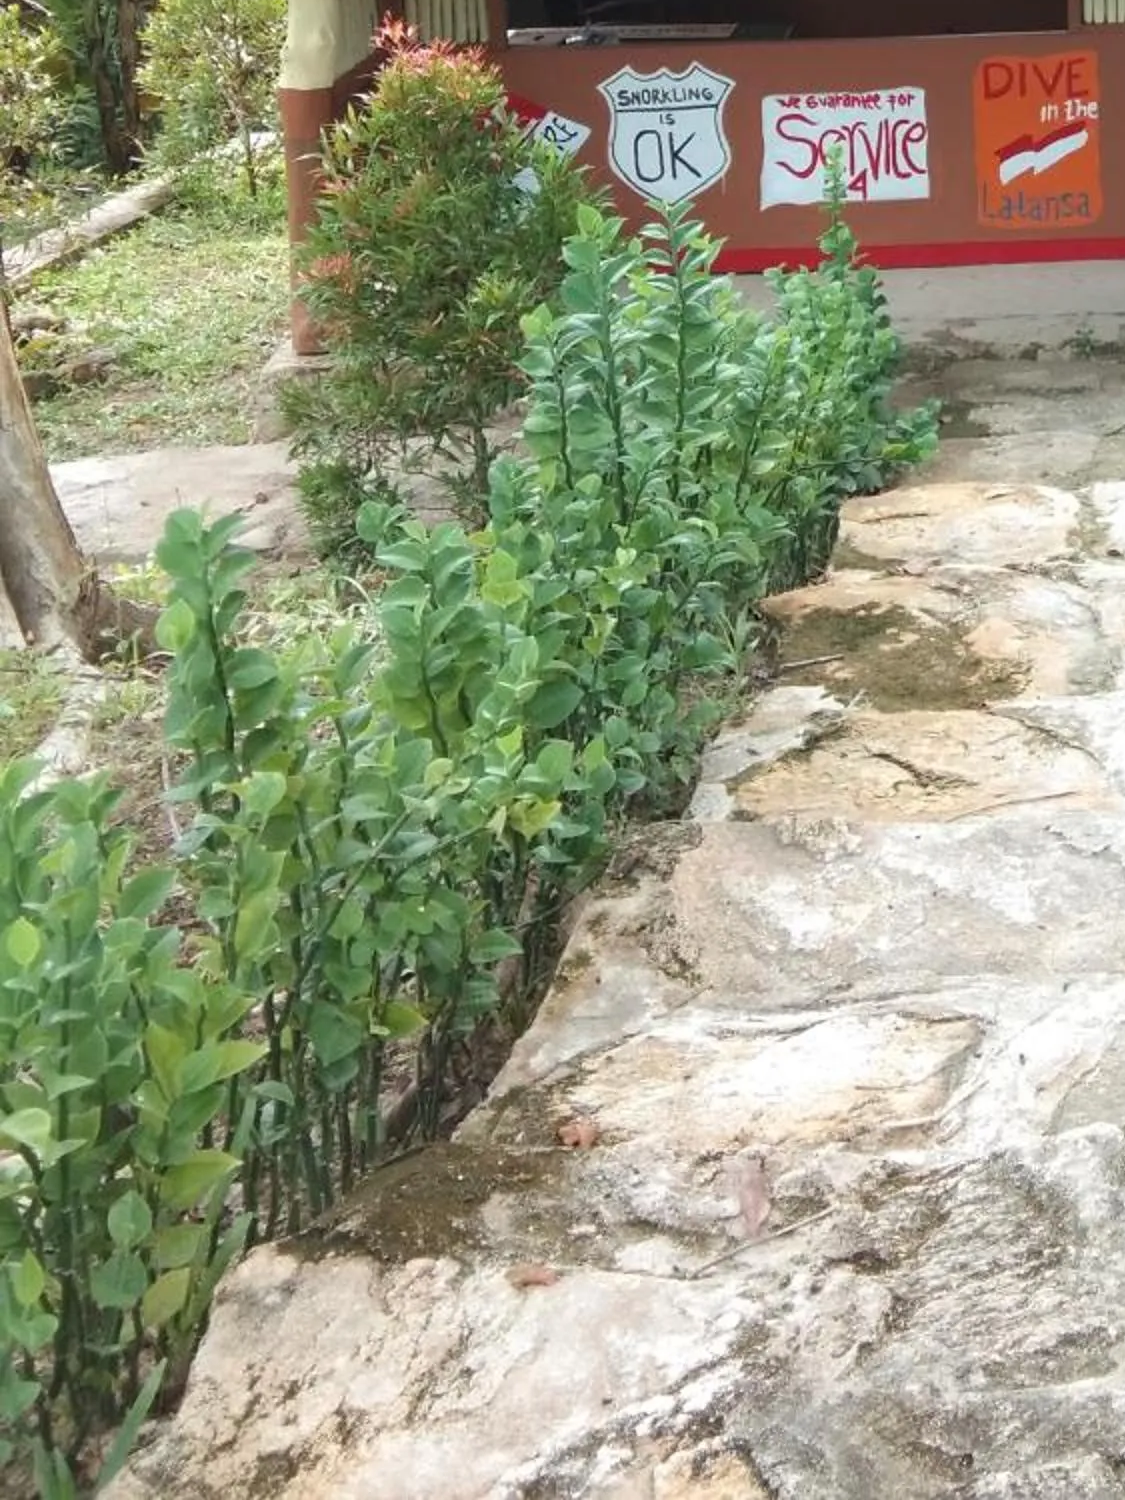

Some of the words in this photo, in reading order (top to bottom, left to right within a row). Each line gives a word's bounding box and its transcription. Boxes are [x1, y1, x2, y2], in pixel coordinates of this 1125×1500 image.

[983, 58, 1089, 100] DIVE
[617, 88, 713, 107] SNORKLING
[1063, 99, 1099, 121] the
[633, 129, 702, 183] OK
